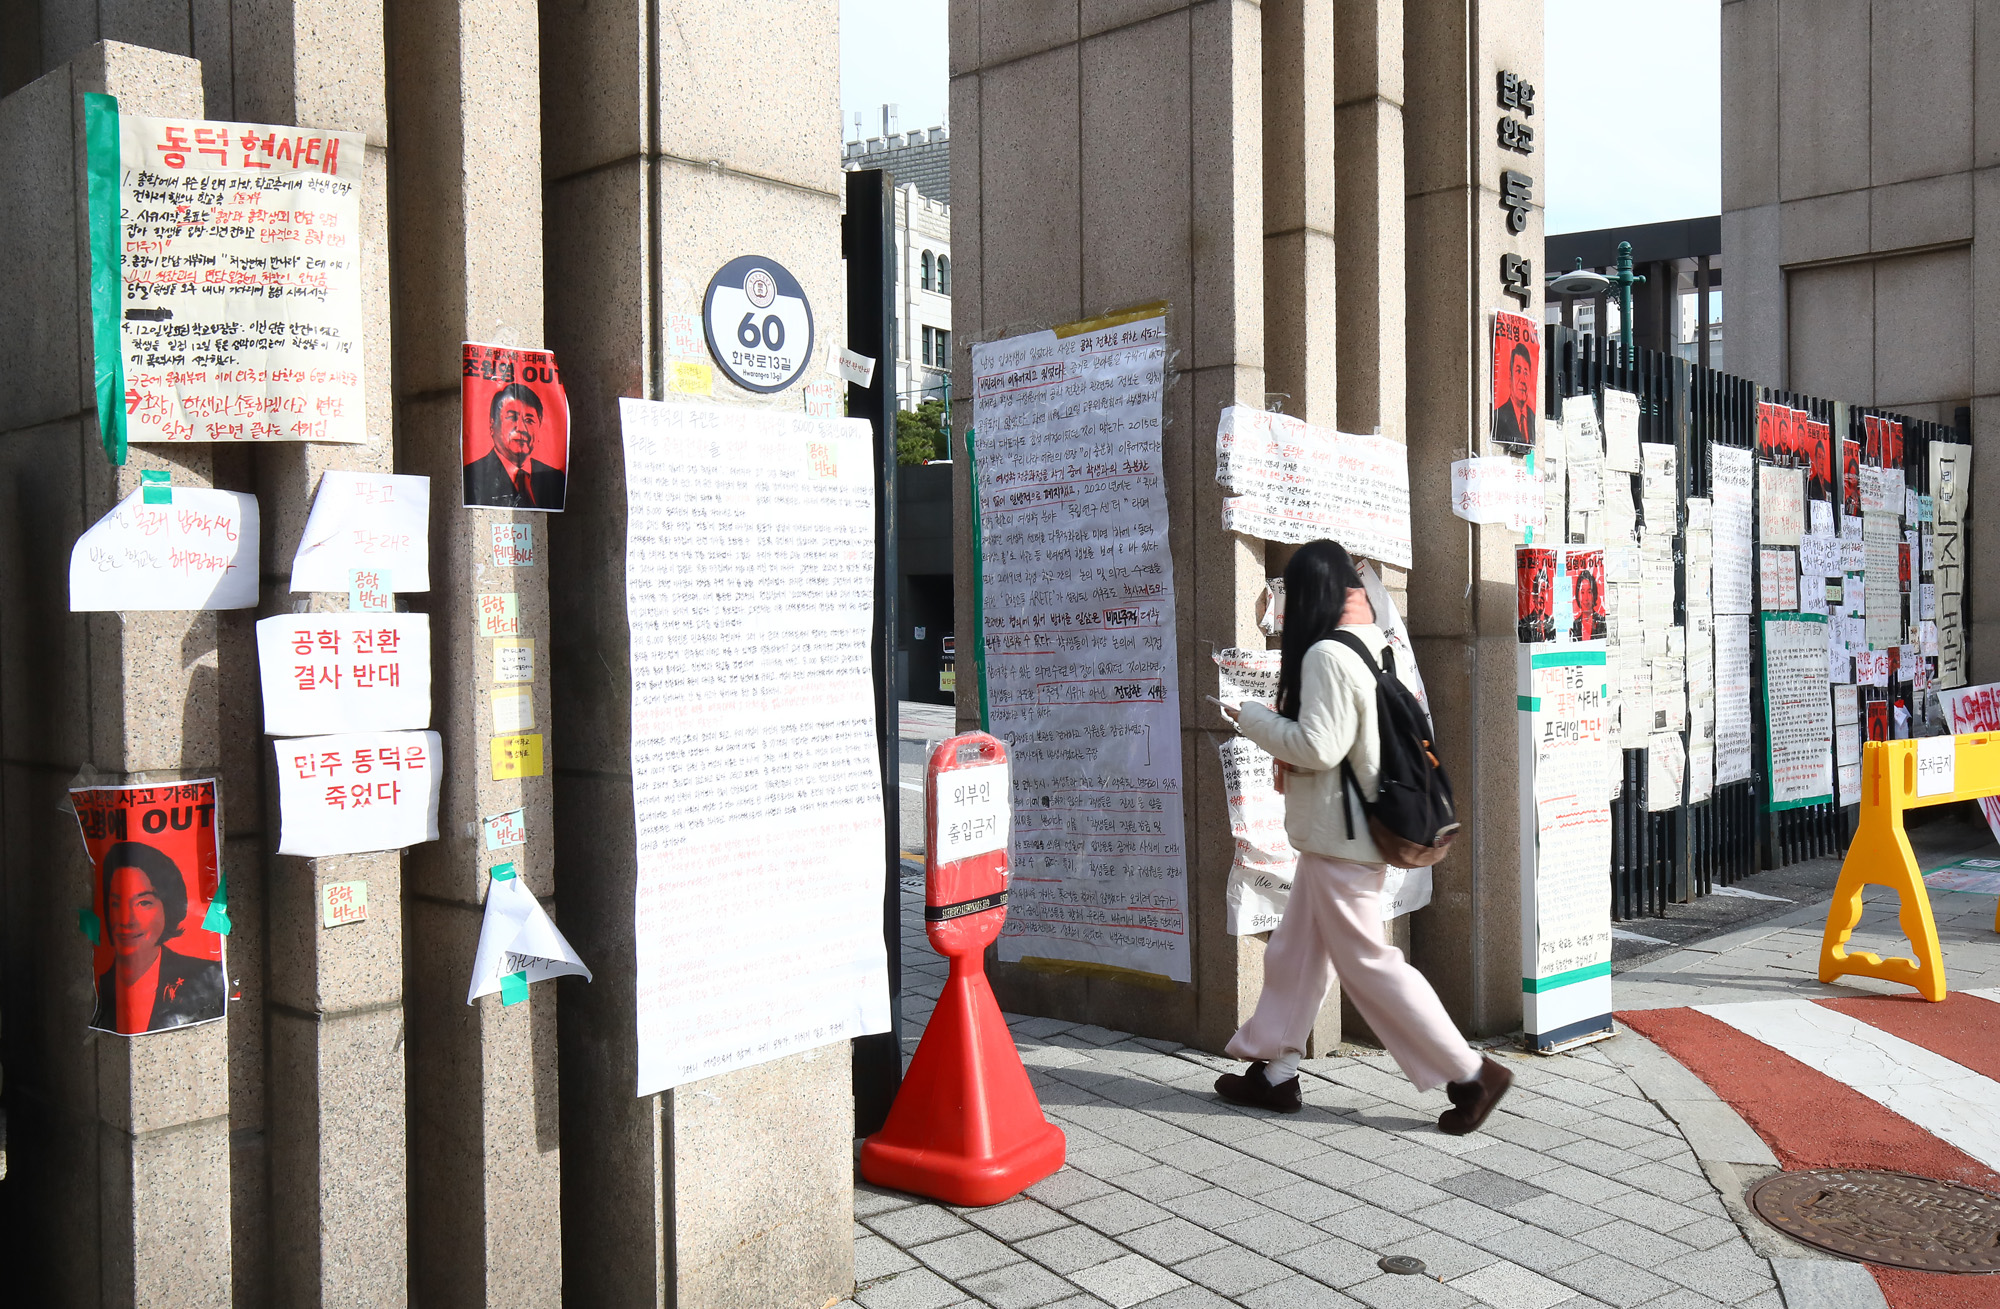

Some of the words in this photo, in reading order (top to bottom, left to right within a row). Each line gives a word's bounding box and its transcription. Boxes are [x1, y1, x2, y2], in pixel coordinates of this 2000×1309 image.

[157, 126, 229, 169] 동덕
[1499, 170, 1533, 311] 동덕
[202, 285, 226, 296] 내내
[670, 314, 694, 335] 공학
[737, 311, 786, 352] 60
[675, 334, 705, 355] 반대
[1079, 338, 1094, 353] 공학
[1095, 334, 1119, 348] 전환을
[1120, 331, 1139, 346] 위한
[463, 358, 516, 383] 조원영
[732, 351, 791, 372] 화랑로13길
[214, 370, 232, 383] 이미
[979, 375, 1006, 391] 비밀리에
[1007, 370, 1039, 386] 이루어지고
[806, 382, 833, 399] 이사장
[1128, 416, 1160, 431] 2015년
[810, 443, 829, 461] 공학
[814, 459, 838, 478] 반대
[1009, 489, 1042, 506] 일방적으로
[133, 503, 169, 537] 몰래
[177, 509, 238, 542] 남학생
[493, 525, 528, 543] 공학이
[168, 547, 238, 576] 해명하라
[1108, 564, 1131, 580] 의견
[354, 571, 380, 590] 공학
[359, 589, 388, 609] 반대
[480, 595, 505, 615] 공학
[486, 614, 519, 635] 반대
[1074, 611, 1102, 626] 일삼은
[1105, 610, 1139, 627] 비민주적
[291, 628, 342, 656] 공학
[351, 628, 401, 654] 전환
[1142, 634, 1163, 651] 직접
[294, 664, 343, 690] 결사
[353, 662, 400, 688] 반대
[1564, 664, 1585, 690] 갈등
[1113, 684, 1143, 700] 정당한
[1577, 690, 1600, 712] 사태
[1543, 719, 1579, 743] 프레임
[294, 751, 343, 780] 민주
[351, 746, 427, 775] 동덕은
[1918, 753, 1953, 777] 주차금지
[118, 788, 156, 808] 사고
[324, 780, 402, 811] 죽었다
[953, 780, 991, 807] 외부인
[142, 802, 216, 835] OUT
[496, 827, 525, 845] 반대
[947, 813, 997, 846] 출입금지
[327, 885, 354, 906] 공학
[332, 903, 369, 923] 반대
